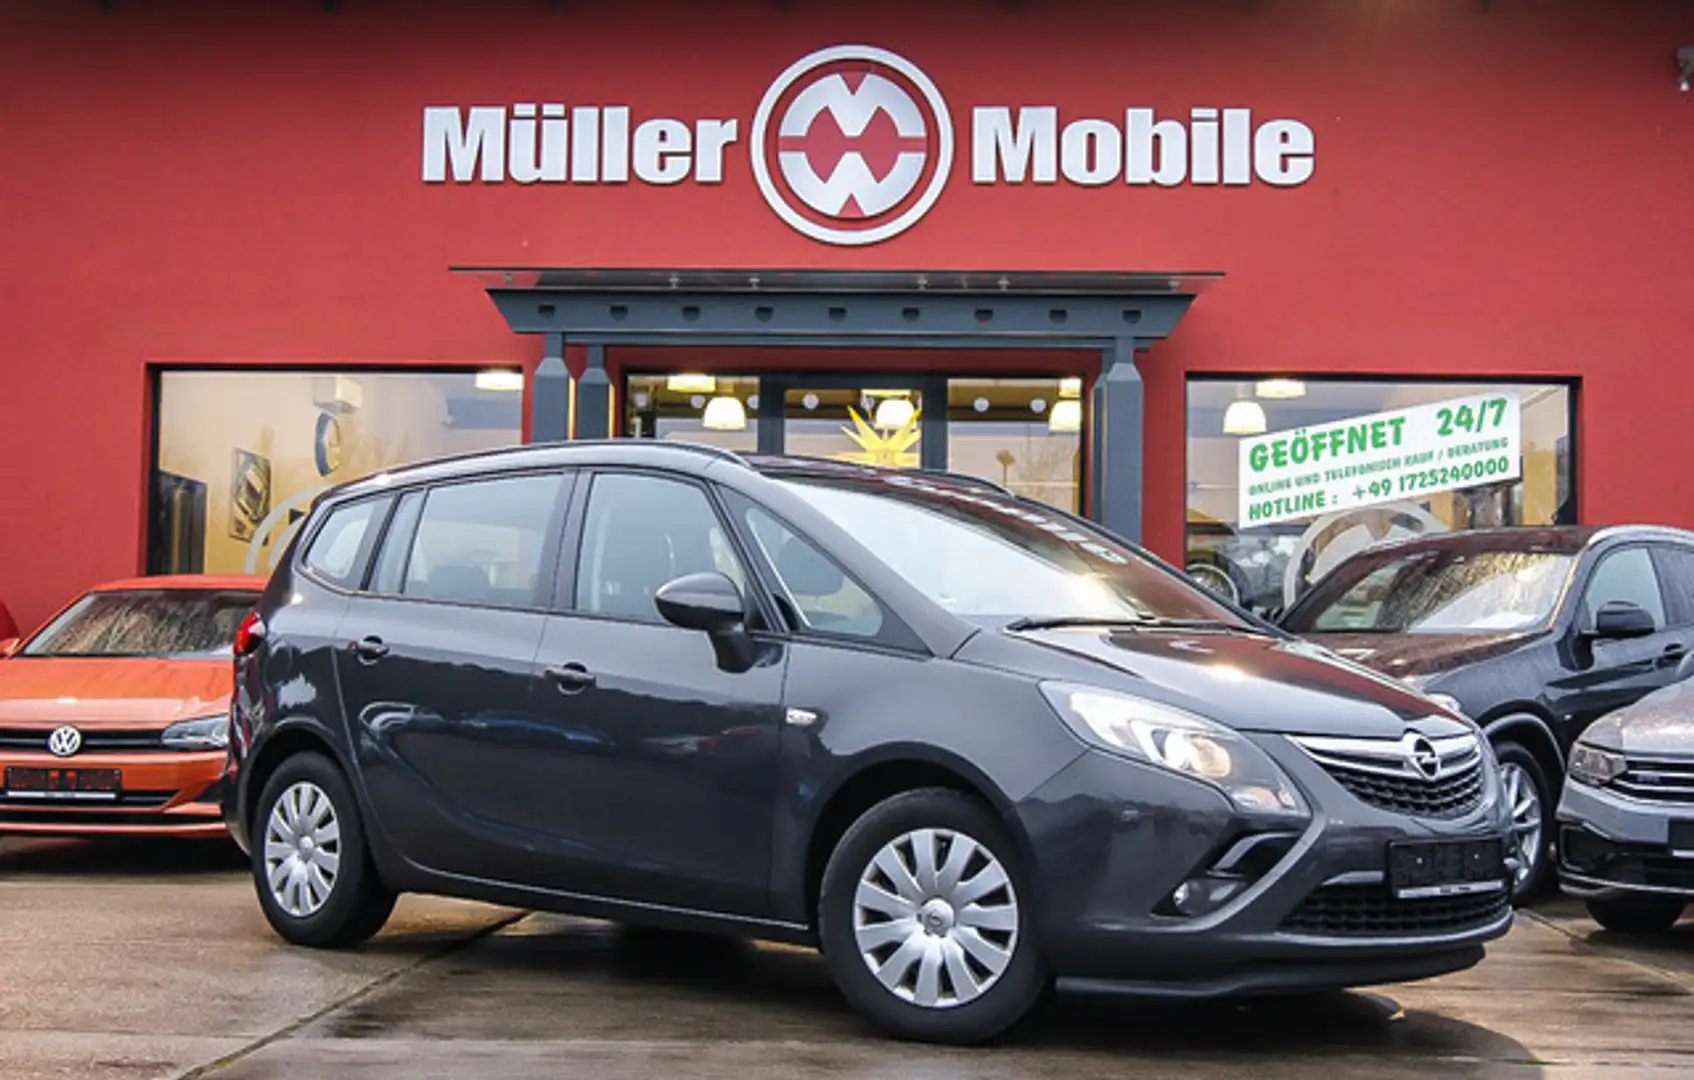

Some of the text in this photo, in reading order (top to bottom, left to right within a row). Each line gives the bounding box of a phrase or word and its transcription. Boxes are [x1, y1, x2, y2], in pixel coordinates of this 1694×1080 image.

[422, 103, 1315, 187] Müller Mobile
[1249, 397, 1507, 472] GEÖFFNET 24/7
[1249, 489, 1326, 520] HOTLINE
[1352, 478, 1392, 499] +49
[1399, 456, 1509, 492] 1725240000
